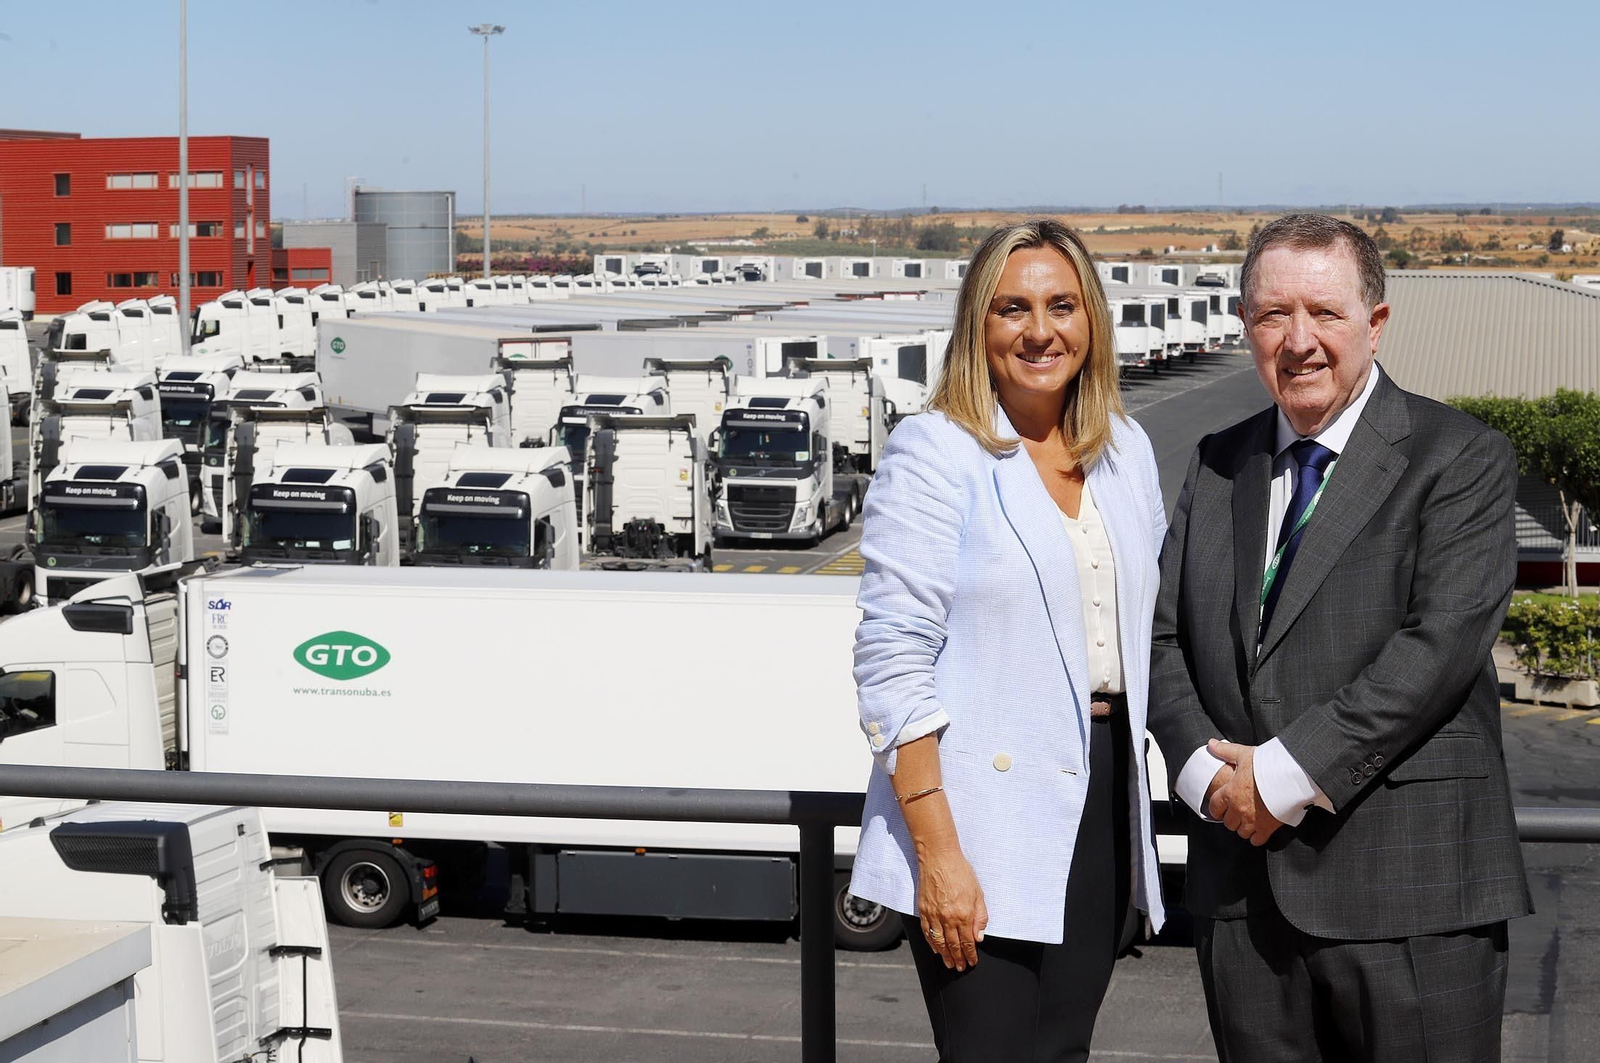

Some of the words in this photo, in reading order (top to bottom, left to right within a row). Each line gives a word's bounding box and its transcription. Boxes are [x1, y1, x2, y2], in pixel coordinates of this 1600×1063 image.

[765, 413, 786, 421] moving
[65, 486, 82, 495] Keep
[82, 487, 91, 495] on
[92, 487, 117, 497] moving
[273, 489, 290, 498] Keep
[290, 490, 300, 498] on
[300, 490, 326, 500] moving
[447, 493, 464, 503] Keep
[464, 494, 473, 502] on
[474, 494, 500, 505] moving
[212, 613, 229, 624] FRC
[305, 643, 378, 667] GTO
[293, 686, 392, 697] www.transonuba.es
